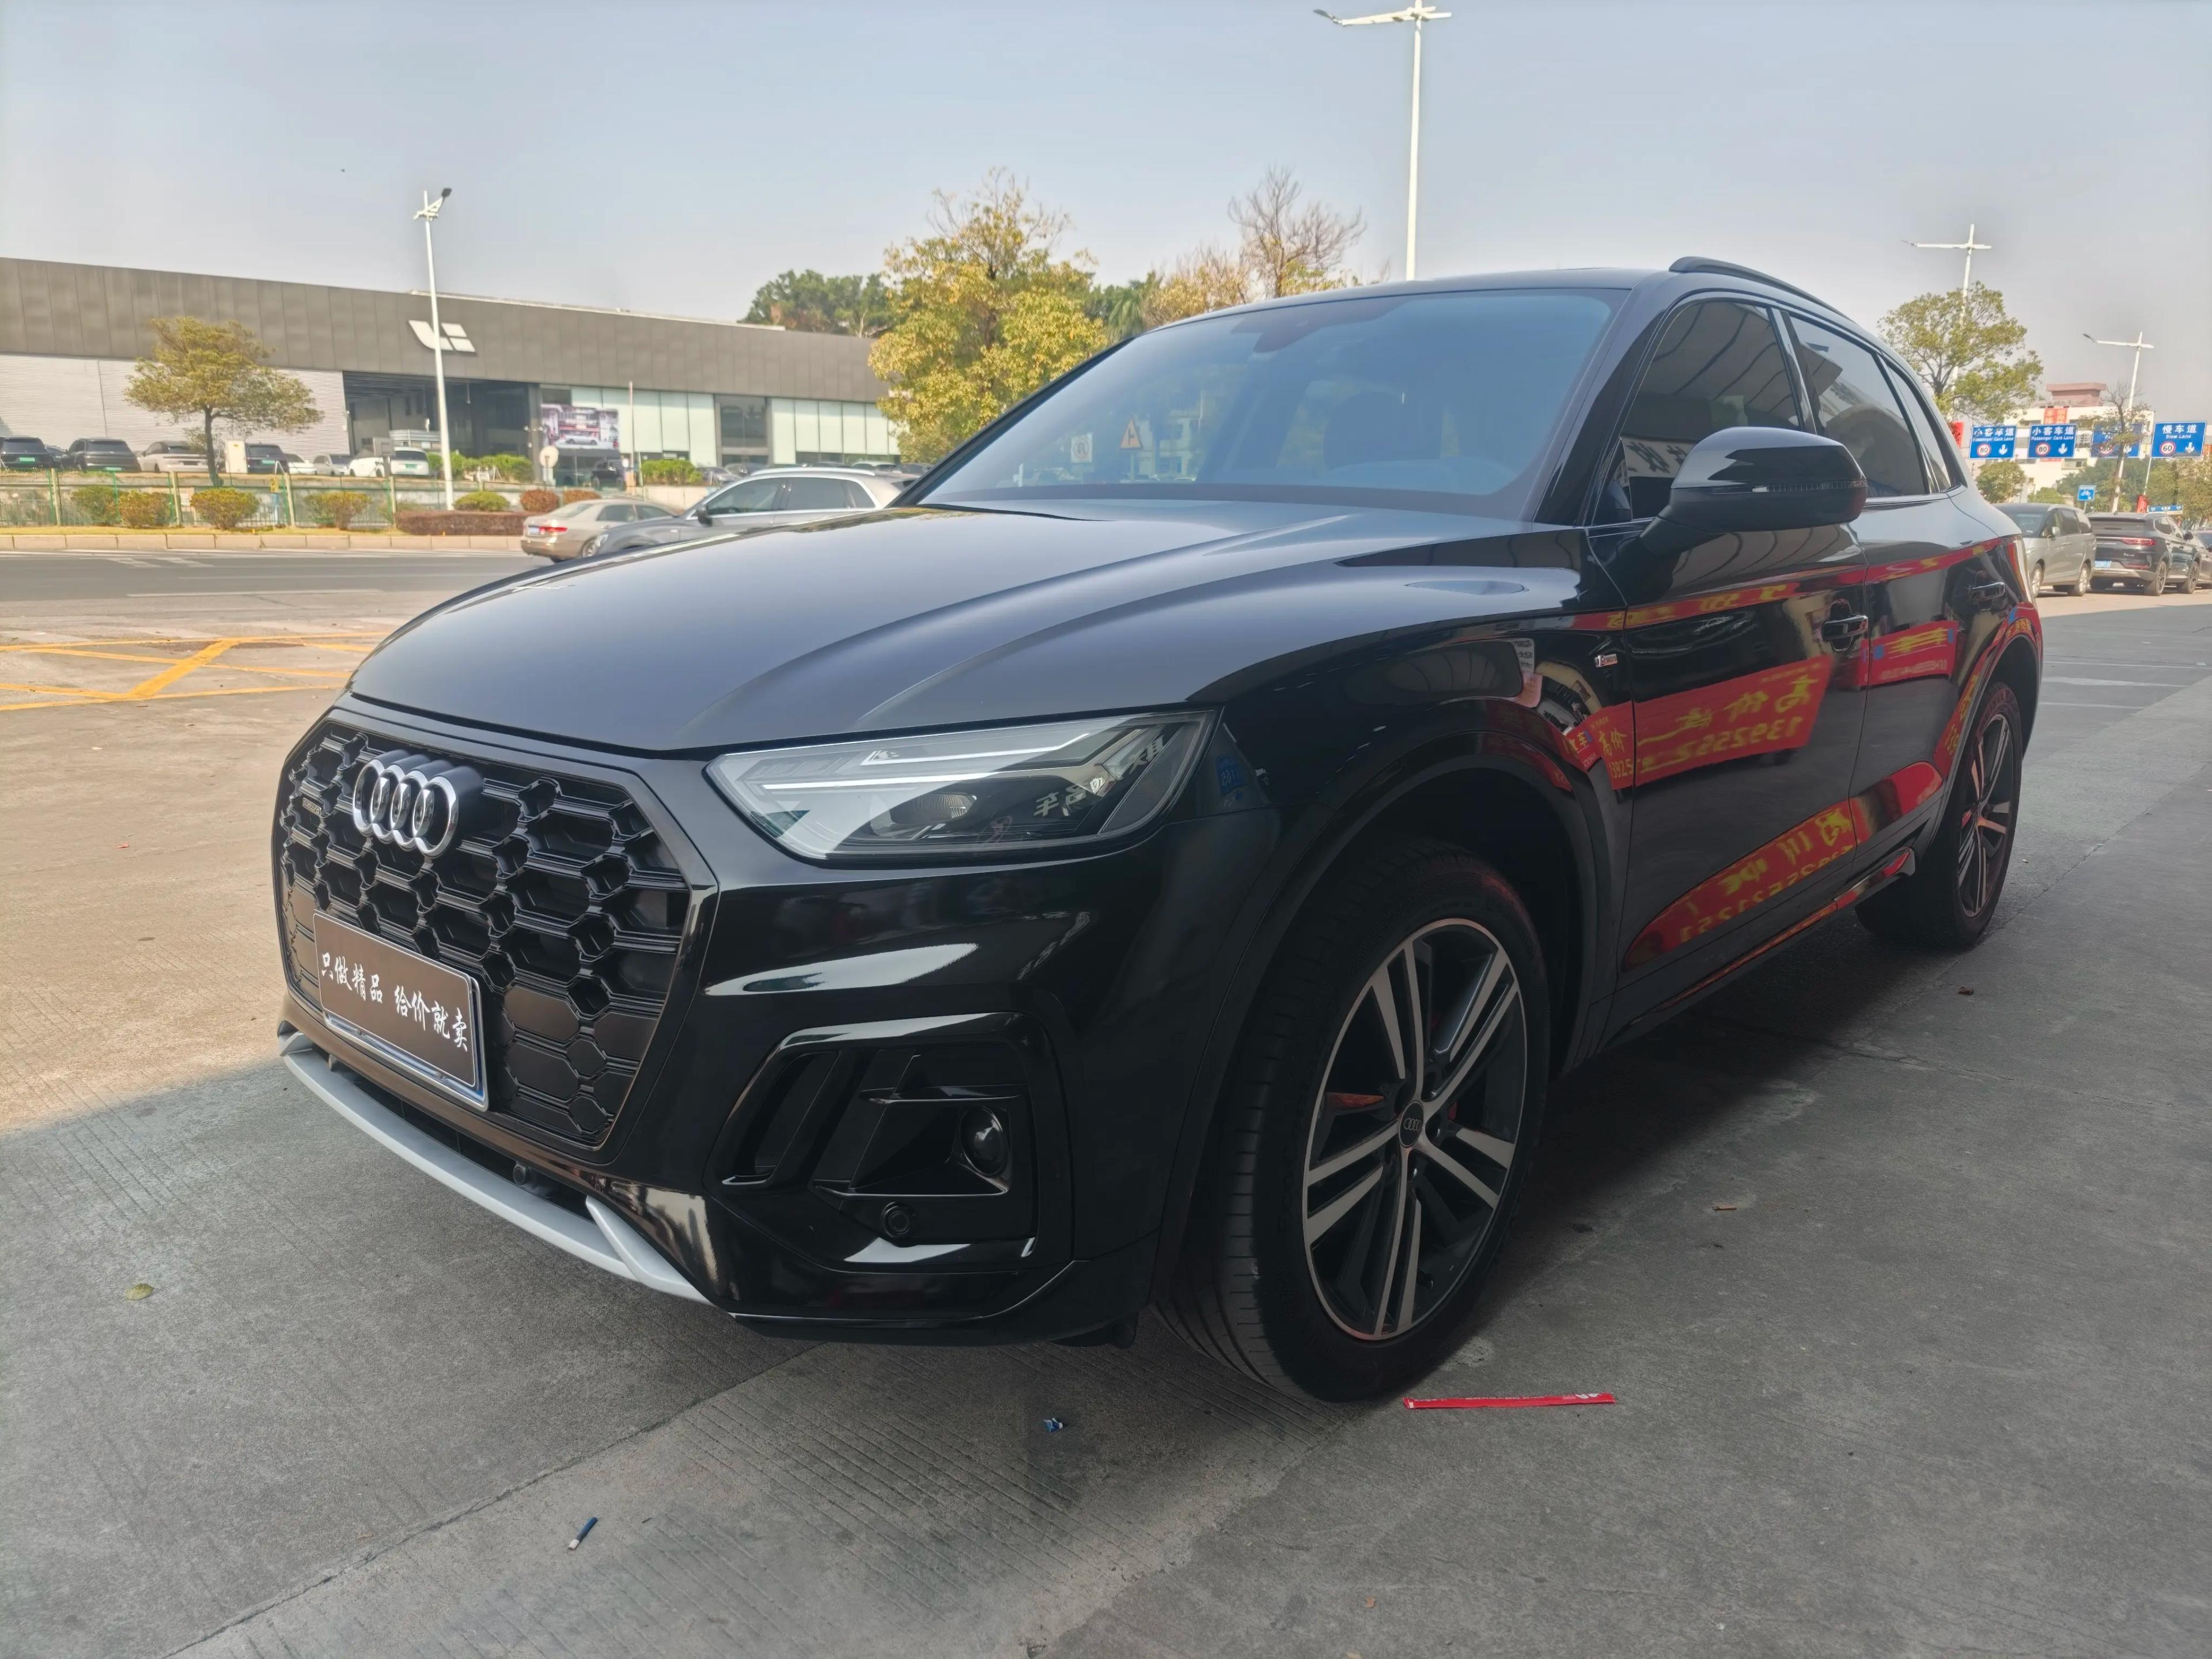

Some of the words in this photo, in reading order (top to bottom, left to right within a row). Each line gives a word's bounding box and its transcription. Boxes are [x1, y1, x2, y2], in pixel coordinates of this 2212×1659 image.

[1974, 427, 2014, 436] 小客车道
[2032, 426, 2074, 435] 小客车道
[2162, 425, 2196, 434] 慢车道
[321, 952, 382, 1004] 只做精品
[394, 985, 468, 1052] 给价就卖
